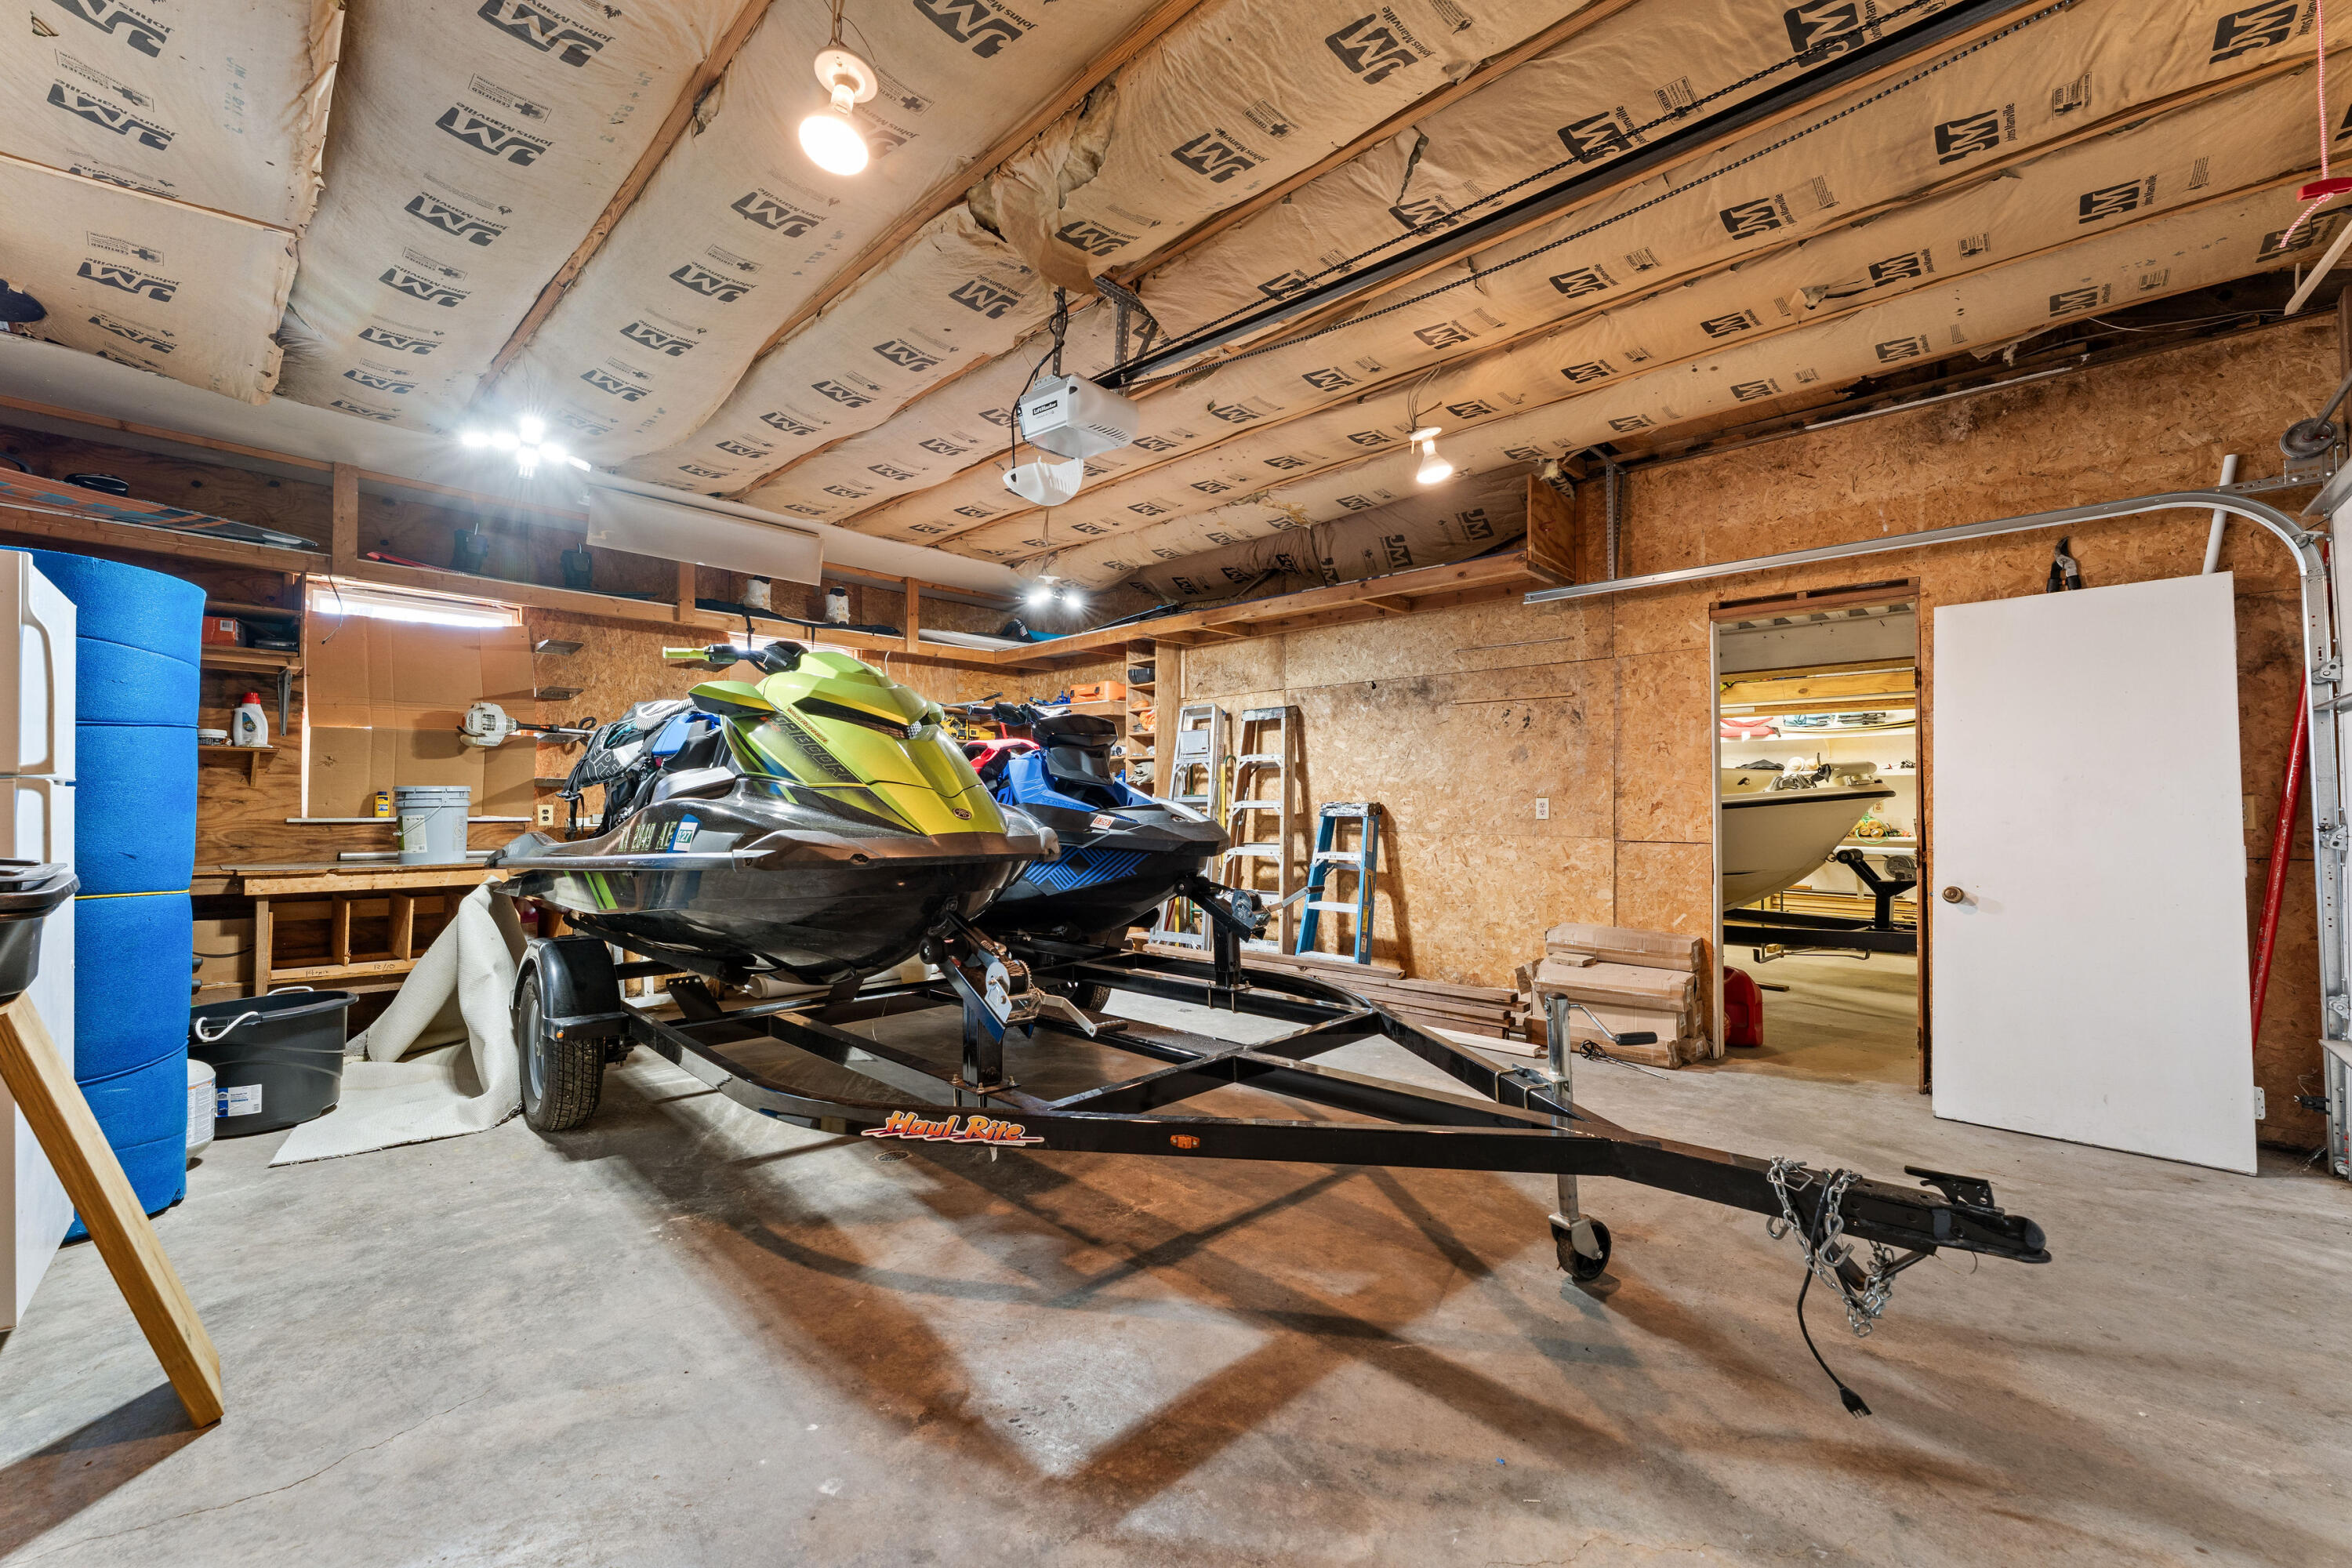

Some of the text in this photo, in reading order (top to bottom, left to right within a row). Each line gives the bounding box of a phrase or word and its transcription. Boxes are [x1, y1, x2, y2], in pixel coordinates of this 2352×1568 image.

[118, 2, 175, 34] Johns
[571, 20, 616, 42] Johns
[913, 0, 1022, 58] JM
[1004, 9, 1038, 31] Johns
[1381, 6, 1412, 42] Manville
[2209, 0, 2298, 64] JM
[2296, 19, 2313, 36] Johns
[1325, 13, 1418, 85] JM
[1411, 40, 1436, 58] Johns
[54, 78, 179, 136] Johns Manville
[471, 87, 510, 108] CERTIFIED
[47, 84, 172, 151] JM
[456, 102, 557, 147] Johns Manville
[889, 122, 920, 139] Johns
[1245, 110, 1267, 129] CERTIFIED
[2003, 103, 2018, 142] Johns Manville
[435, 107, 546, 166] JM
[1215, 127, 1270, 163] Johns Manville
[1934, 110, 1999, 165] JM
[1171, 133, 1255, 183] JM
[758, 188, 829, 221] Johns Manville
[2079, 179, 2141, 224] JM
[2142, 174, 2158, 206] Johns Manville
[404, 195, 502, 246] JM
[422, 191, 510, 230] Johns Manville
[731, 191, 818, 238] JM
[1719, 198, 1781, 240] JM
[1775, 193, 1797, 226] Johns Manville
[1054, 221, 1131, 256] JM
[77, 262, 176, 302] JM
[85, 257, 182, 285] Johns Manville
[394, 263, 473, 295] Johns Manville
[670, 265, 750, 303] JM
[691, 262, 759, 289] Johns Manville
[1549, 267, 1607, 299] JM
[1868, 252, 1921, 288] JM
[379, 268, 466, 307] JM
[949, 280, 1019, 319] JM
[977, 274, 1029, 299] Johns Manville
[2049, 285, 2098, 317] JM
[88, 317, 175, 354] JM
[358, 328, 438, 354] JM
[619, 322, 693, 356] JM
[1414, 323, 1469, 350] JM
[1700, 312, 1751, 338] JM
[873, 340, 938, 372] JM
[1875, 337, 1920, 363] JM
[343, 370, 416, 394] JM
[580, 370, 648, 401] JM
[1301, 368, 1355, 392] JM
[1560, 361, 1610, 384] JM
[811, 379, 872, 408] JM
[1730, 379, 1773, 401] JM
[759, 412, 817, 435] JM
[1210, 406, 1259, 423] JM
[1446, 401, 1493, 419] JM
[1608, 416, 1649, 433] JM
[715, 441, 770, 458] JM
[919, 439, 968, 456] JM
[1132, 437, 1178, 452] JM
[1347, 431, 1391, 446] JM
[867, 464, 915, 480] JM
[1264, 456, 1305, 469] JM
[1190, 481, 1231, 494] JM
[1337, 495, 1374, 510] JM
[1461, 508, 1494, 540] JM
[1383, 535, 1413, 568] JM
[681, 831, 691, 842] 27
[885, 1111, 1025, 1141] Haul Rite
